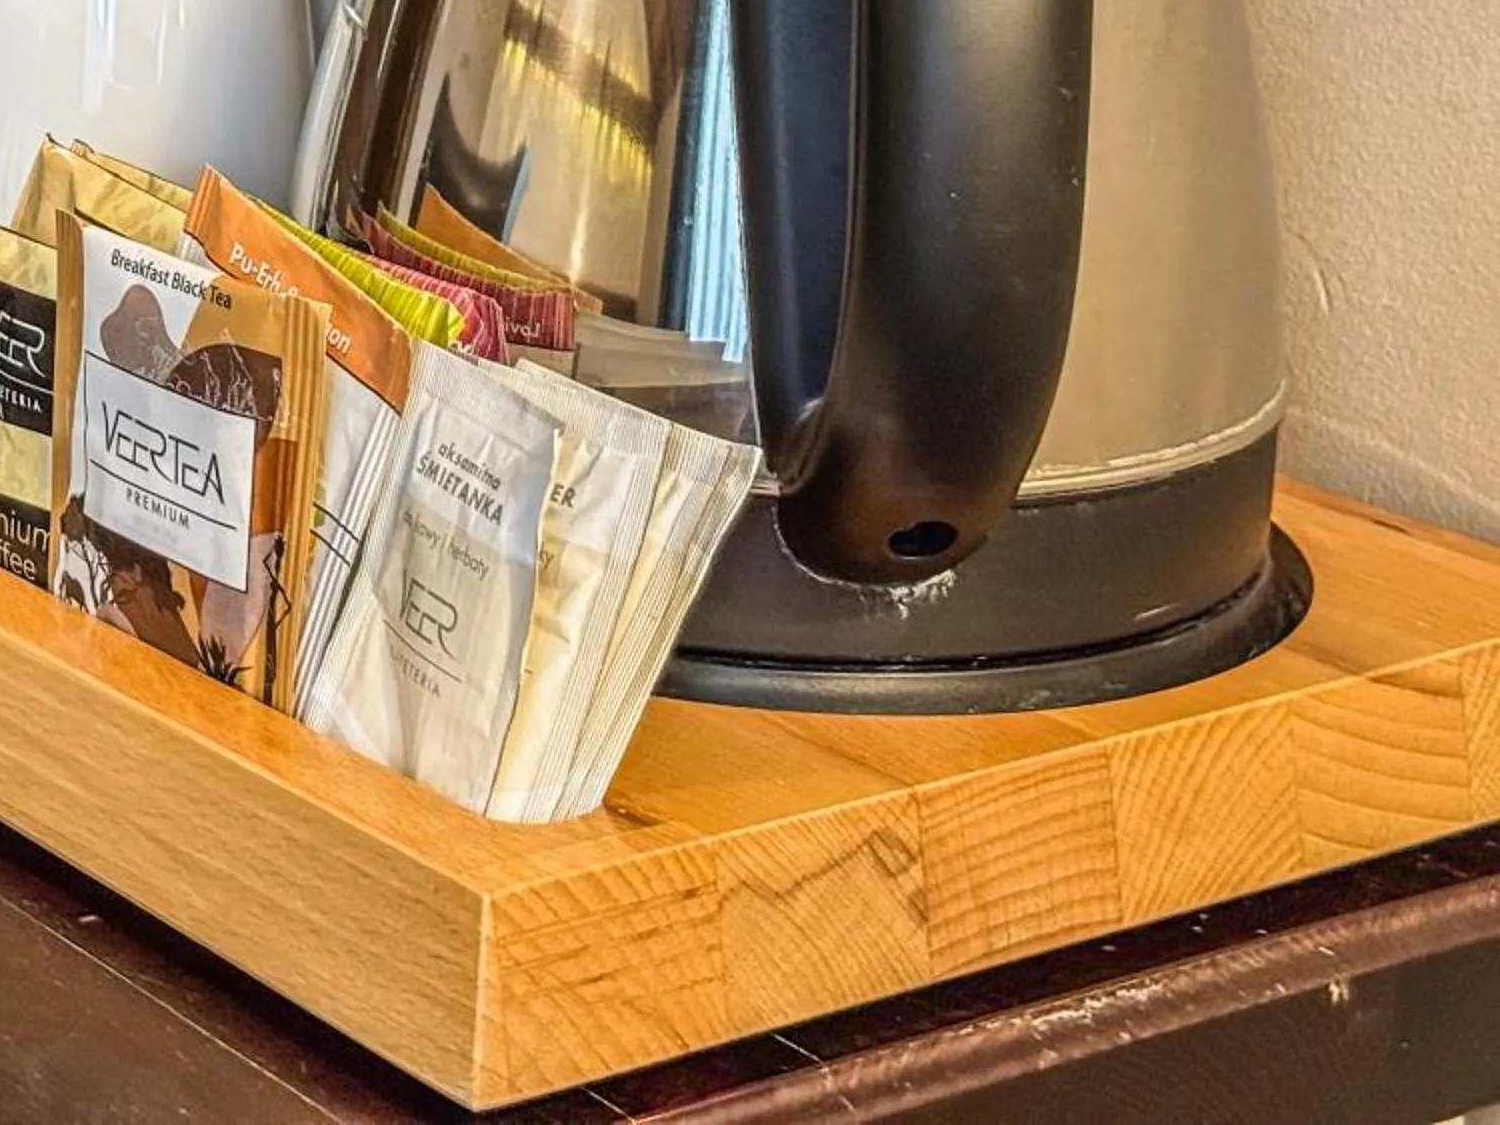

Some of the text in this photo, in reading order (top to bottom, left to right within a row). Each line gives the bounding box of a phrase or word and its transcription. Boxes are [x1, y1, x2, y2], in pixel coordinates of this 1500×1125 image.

[111, 249, 232, 309] Breakfast Black Tea
[126, 488, 190, 530] PREMIUM
[417, 450, 504, 525] ŚMIETANKA
